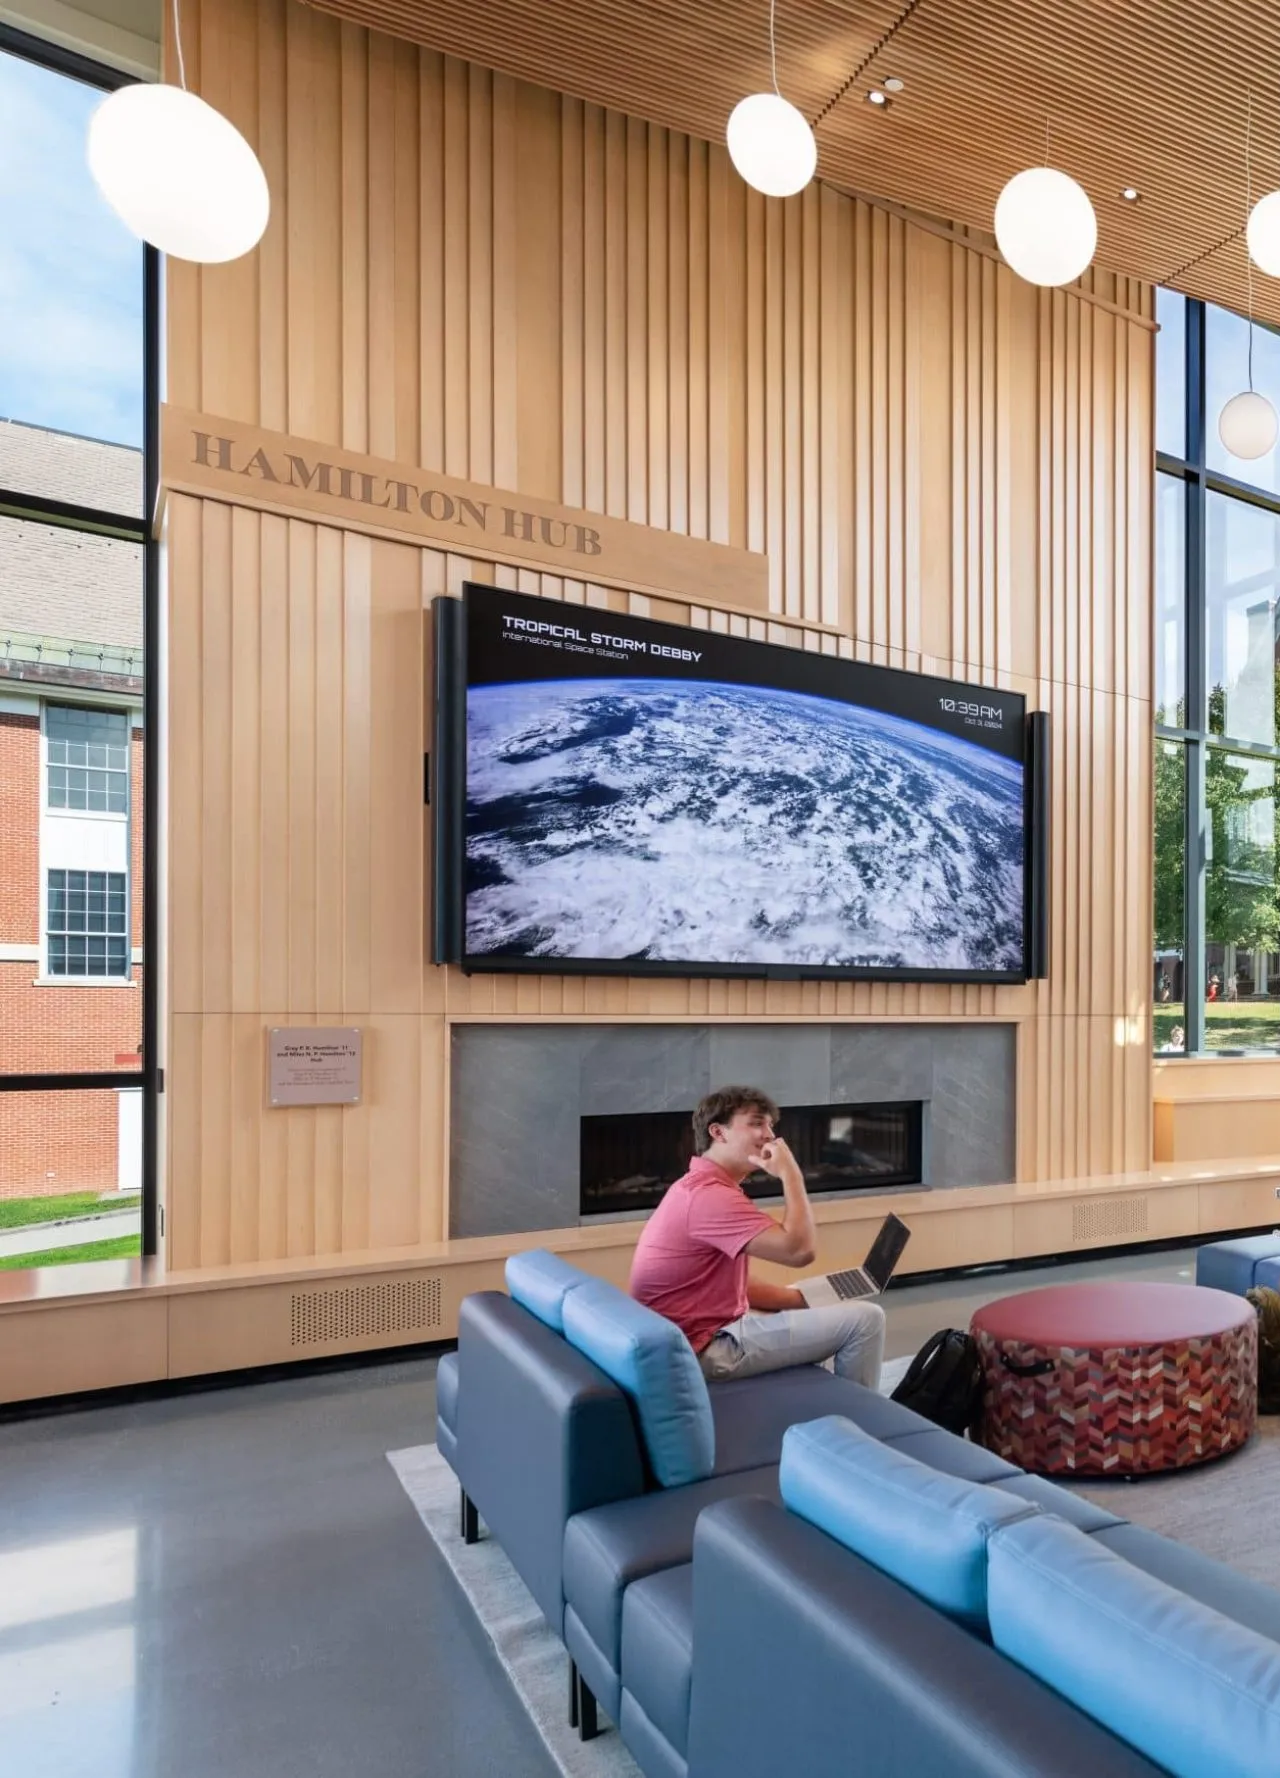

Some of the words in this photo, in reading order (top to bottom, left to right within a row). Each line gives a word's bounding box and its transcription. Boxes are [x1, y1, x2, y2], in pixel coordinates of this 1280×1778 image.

[190, 430, 492, 531] HAMILTON
[501, 506, 602, 556] HUB
[502, 615, 587, 642] TROPICAL
[590, 632, 646, 653] STORM
[650, 643, 703, 662] DEBBY
[502, 631, 562, 648] International
[564, 641, 595, 655] Space
[597, 647, 629, 661] Station
[980, 705, 1003, 720] AM
